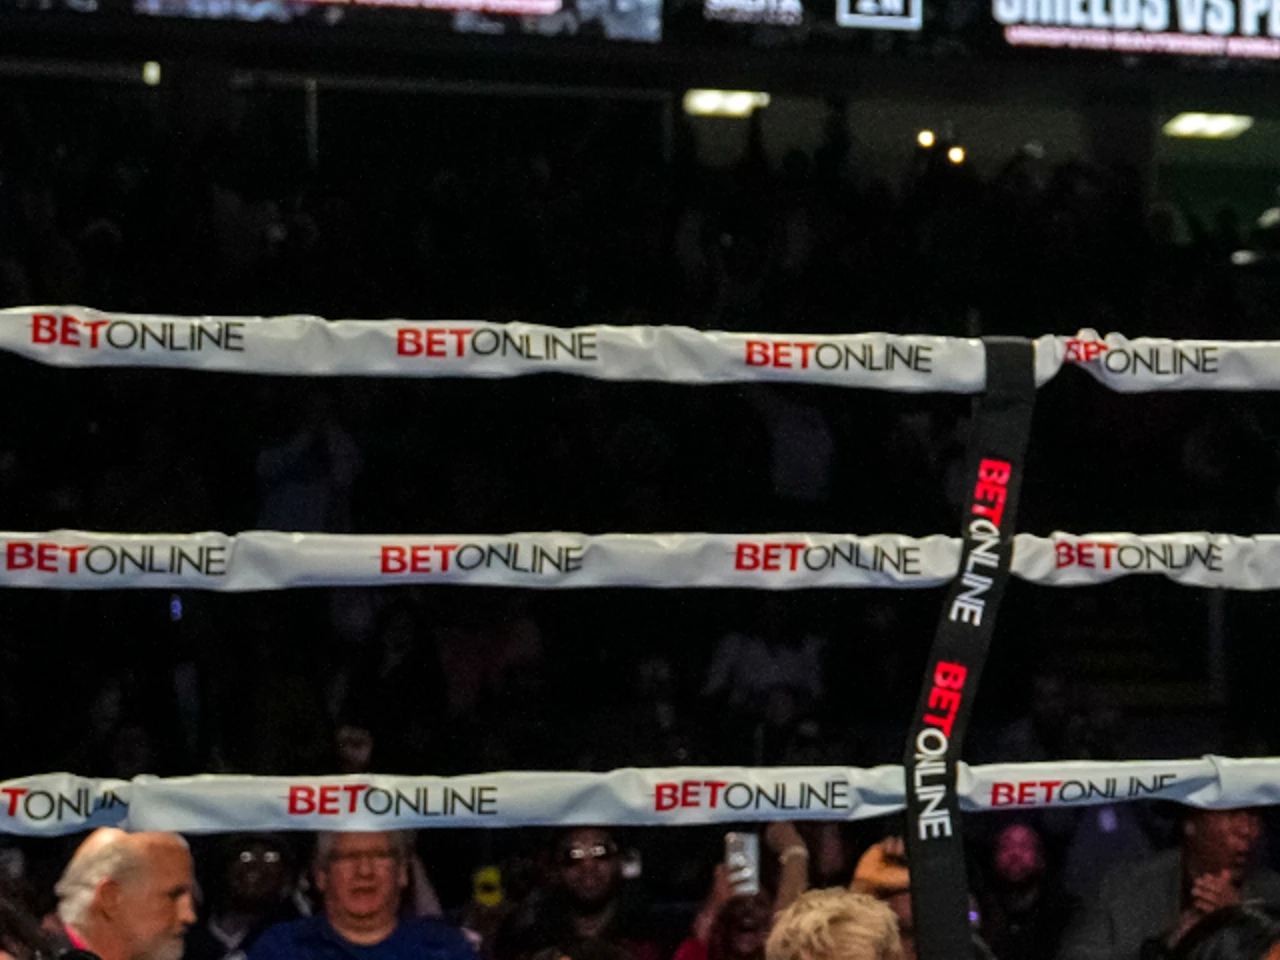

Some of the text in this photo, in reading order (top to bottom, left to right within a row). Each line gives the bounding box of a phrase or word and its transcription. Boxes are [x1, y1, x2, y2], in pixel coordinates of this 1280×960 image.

[31, 314, 245, 352] BETONLINE
[397, 327, 597, 361] BETONLINE
[745, 340, 932, 372] BETONLINE
[4, 542, 226, 575] BETONLINE
[950, 458, 1012, 626] BETONLINE
[1054, 541, 1223, 573] BETONLINE
[379, 543, 583, 575] BETONLINE
[735, 543, 921, 575] BETONLINE
[916, 660, 968, 840] BETONLINE
[287, 783, 497, 816] BETONLINE
[655, 780, 848, 811] BETONLINE
